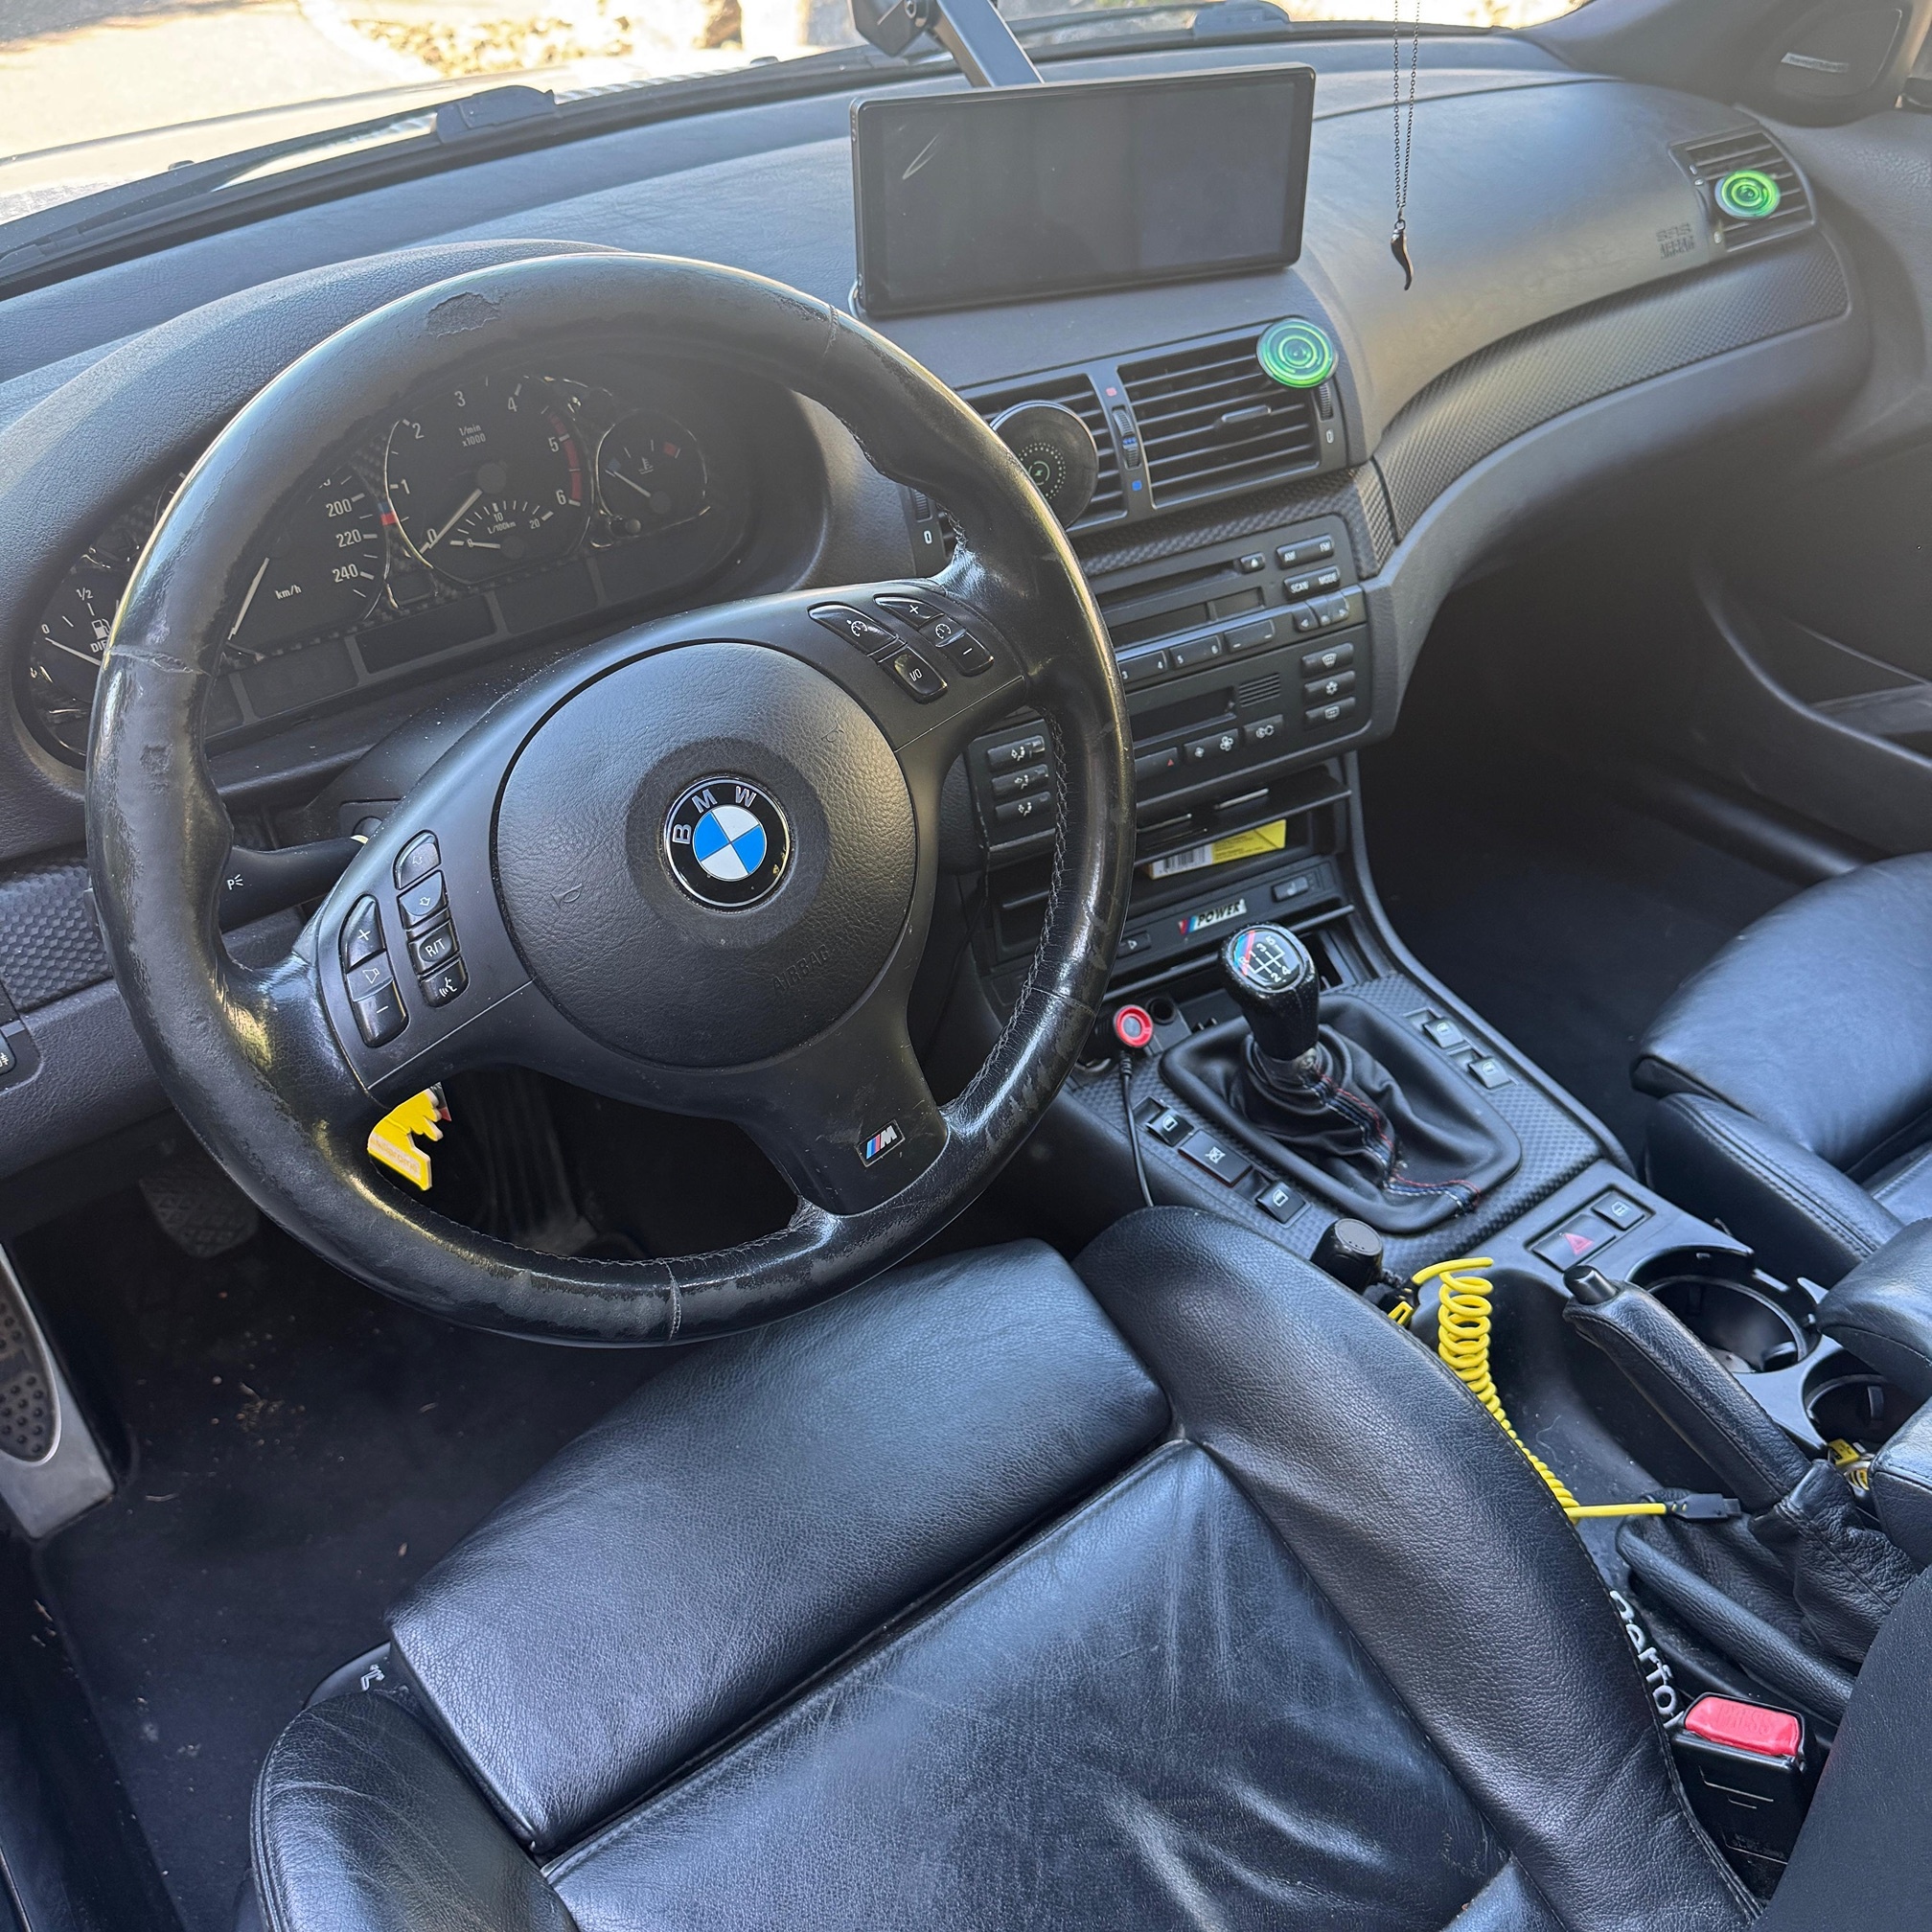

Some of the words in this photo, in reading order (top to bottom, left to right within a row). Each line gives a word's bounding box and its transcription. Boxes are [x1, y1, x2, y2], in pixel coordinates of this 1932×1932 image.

[454, 391, 466, 406] 3
[508, 397, 518, 412] 4
[412, 423, 425, 439] 2
[462, 433, 486, 447] x1000
[548, 437, 559, 452] 5
[401, 479, 410, 494] 1
[556, 490, 566, 505] 6
[326, 498, 352, 518] 200
[494, 512, 503, 522] 10
[529, 518, 540, 529] 20
[335, 529, 361, 547] 220
[426, 528, 438, 544] 0
[924, 530, 932, 544] 0
[332, 564, 358, 583] 240
[76, 587, 93, 601] 1/2
[275, 585, 302, 599] km/h
[1291, 581, 1309, 593] SCAN
[41, 624, 50, 633] 0
[1211, 645, 1218, 654] 6
[1122, 671, 1128, 679] 3
[672, 786, 756, 844] BMW
[1198, 901, 1241, 925] POWER
[425, 938, 445, 956] R/T
[1256, 943, 1266, 952] 3
[1265, 935, 1276, 946] 5
[1281, 965, 1291, 975] 4
[1271, 973, 1280, 983] 2
